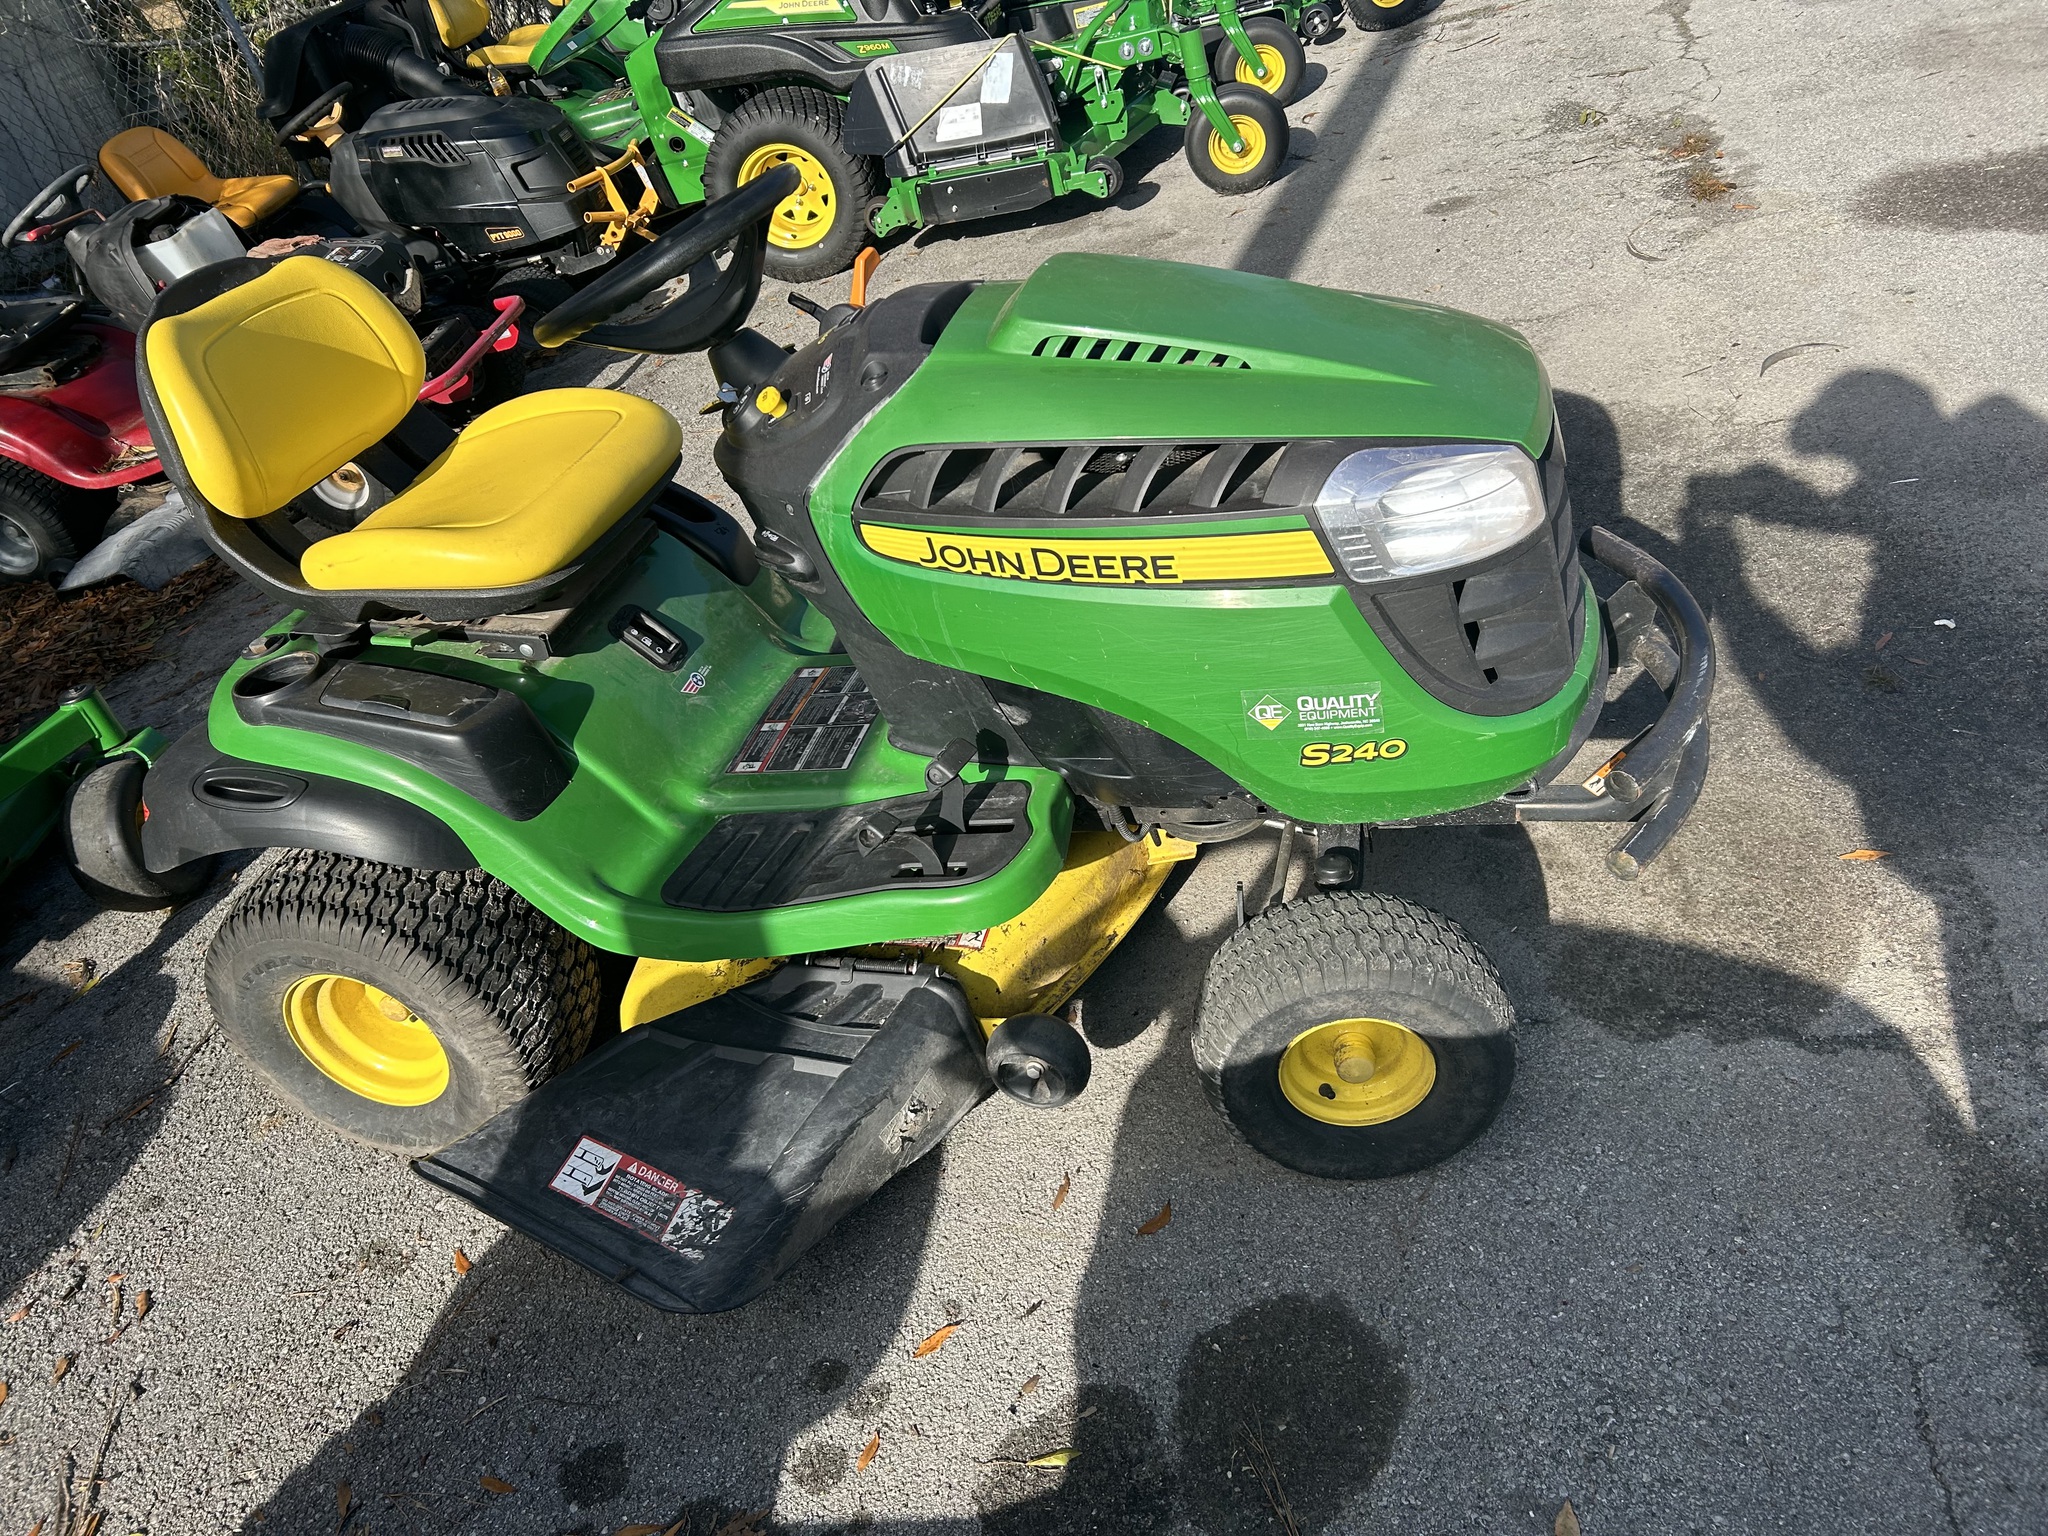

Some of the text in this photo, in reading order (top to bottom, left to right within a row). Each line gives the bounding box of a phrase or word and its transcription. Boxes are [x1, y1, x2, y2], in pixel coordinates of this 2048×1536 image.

[779, 0, 829, 9] JOHN DEERE
[856, 42, 890, 54] Z960M
[919, 537, 1178, 580] JOHN DEERE
[1297, 693, 1380, 711] QUALITY
[1255, 704, 1284, 719] QE
[1299, 707, 1377, 721] EQUIPMENT
[1300, 738, 1408, 767] S240
[242, 956, 291, 986] TURF
[638, 1166, 679, 1191] DANGER
